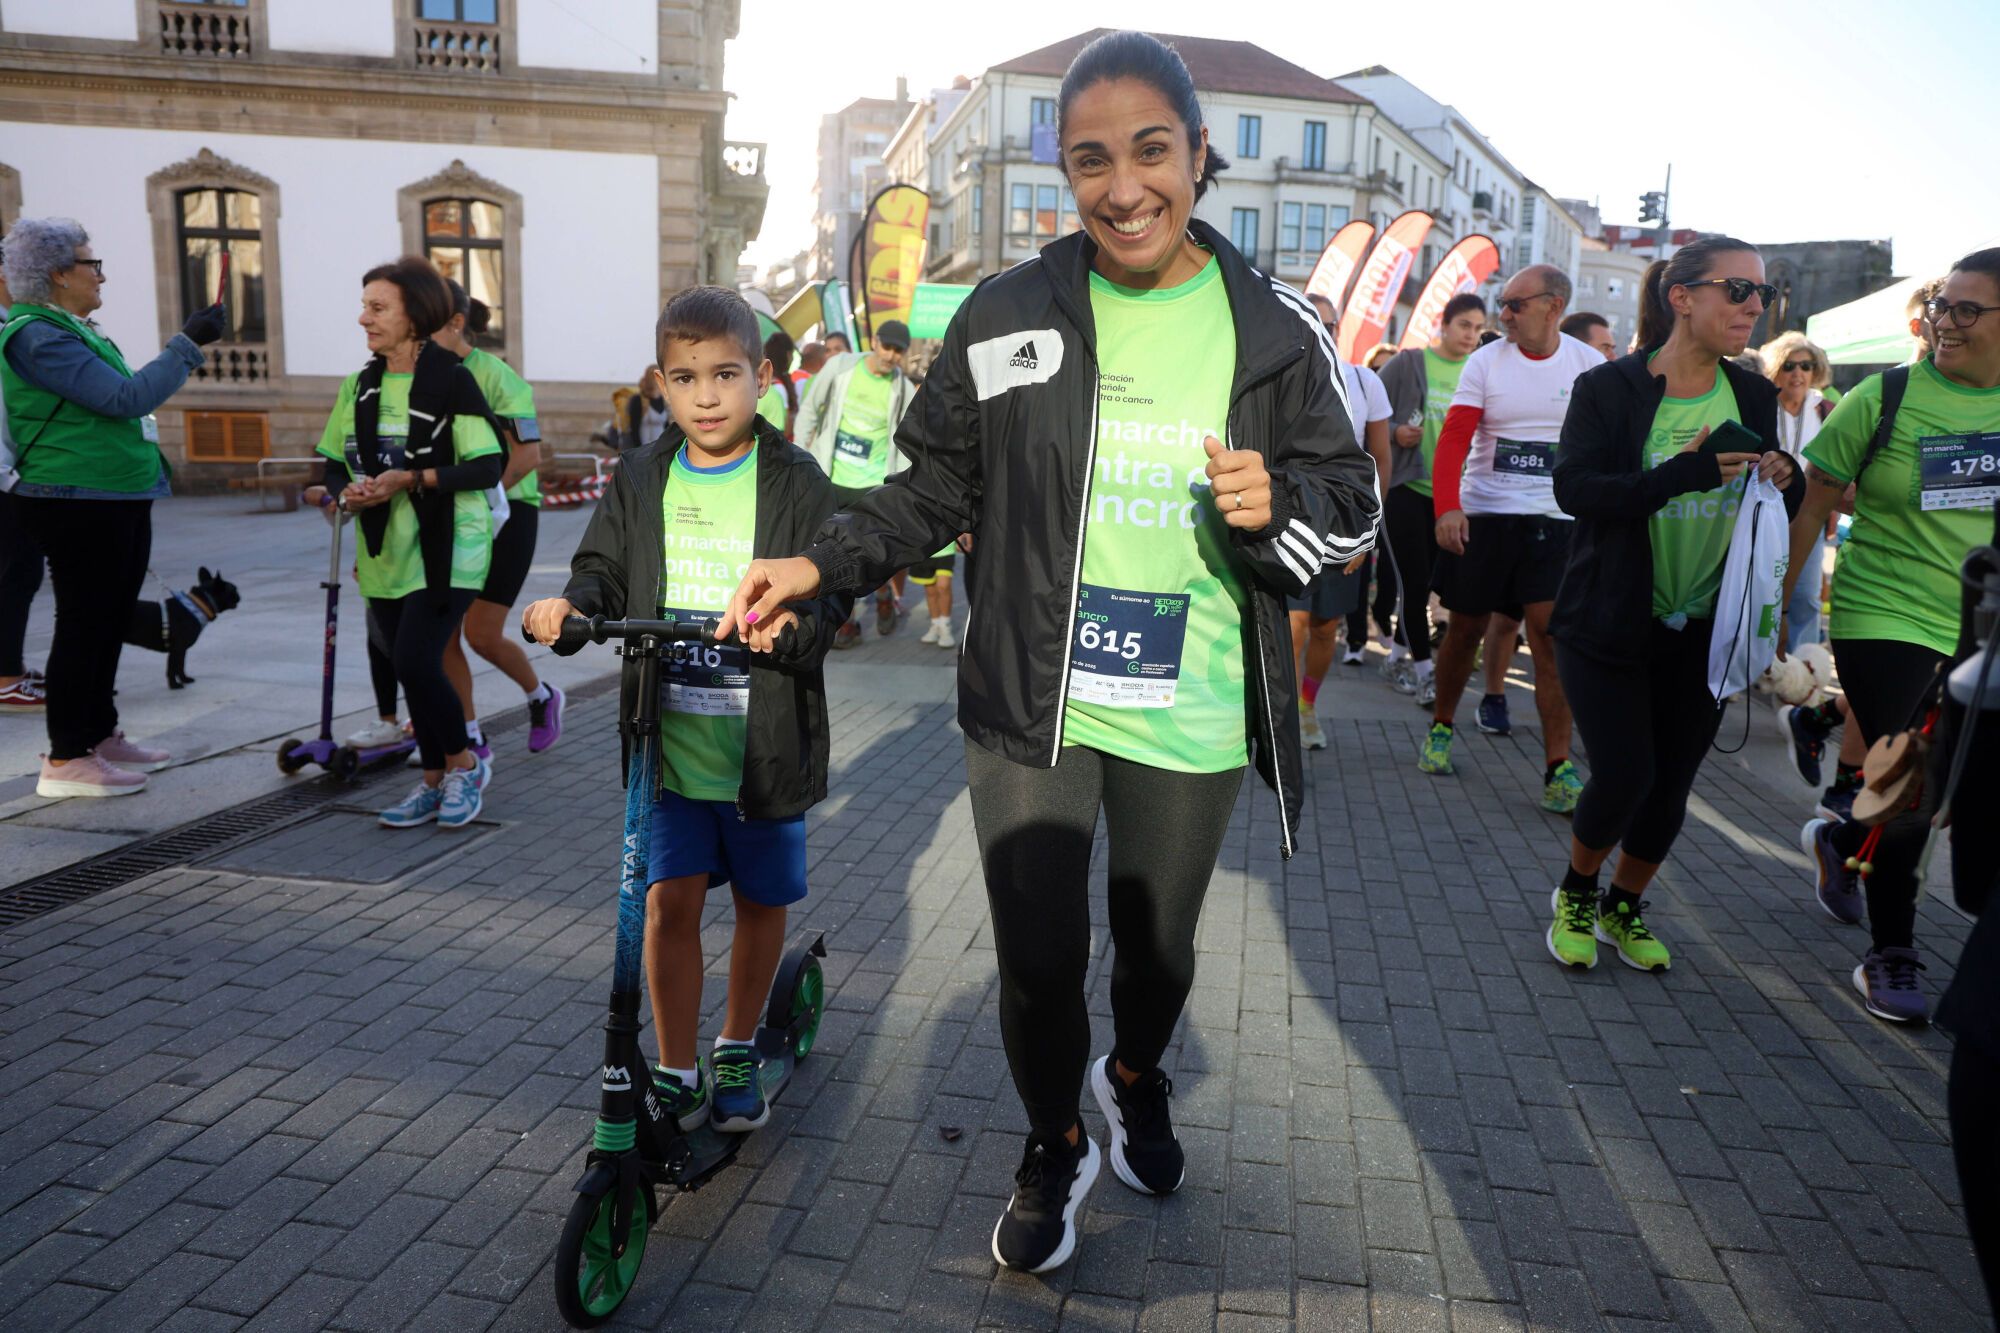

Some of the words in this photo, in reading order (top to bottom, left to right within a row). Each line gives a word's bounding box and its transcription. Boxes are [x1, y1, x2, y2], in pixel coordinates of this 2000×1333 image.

[1098, 372, 1134, 383] ociación
[1100, 384, 1126, 393] añola
[1123, 396, 1153, 405] cancro
[1095, 450, 1173, 489] ntra
[1510, 454, 1545, 468] 0581
[1088, 492, 1205, 529] ncro
[680, 533, 754, 552] marcha
[666, 556, 729, 579] ontra
[667, 582, 734, 606] ancr
[1077, 610, 1108, 623] ancro
[643, 1087, 661, 1121] WILD
